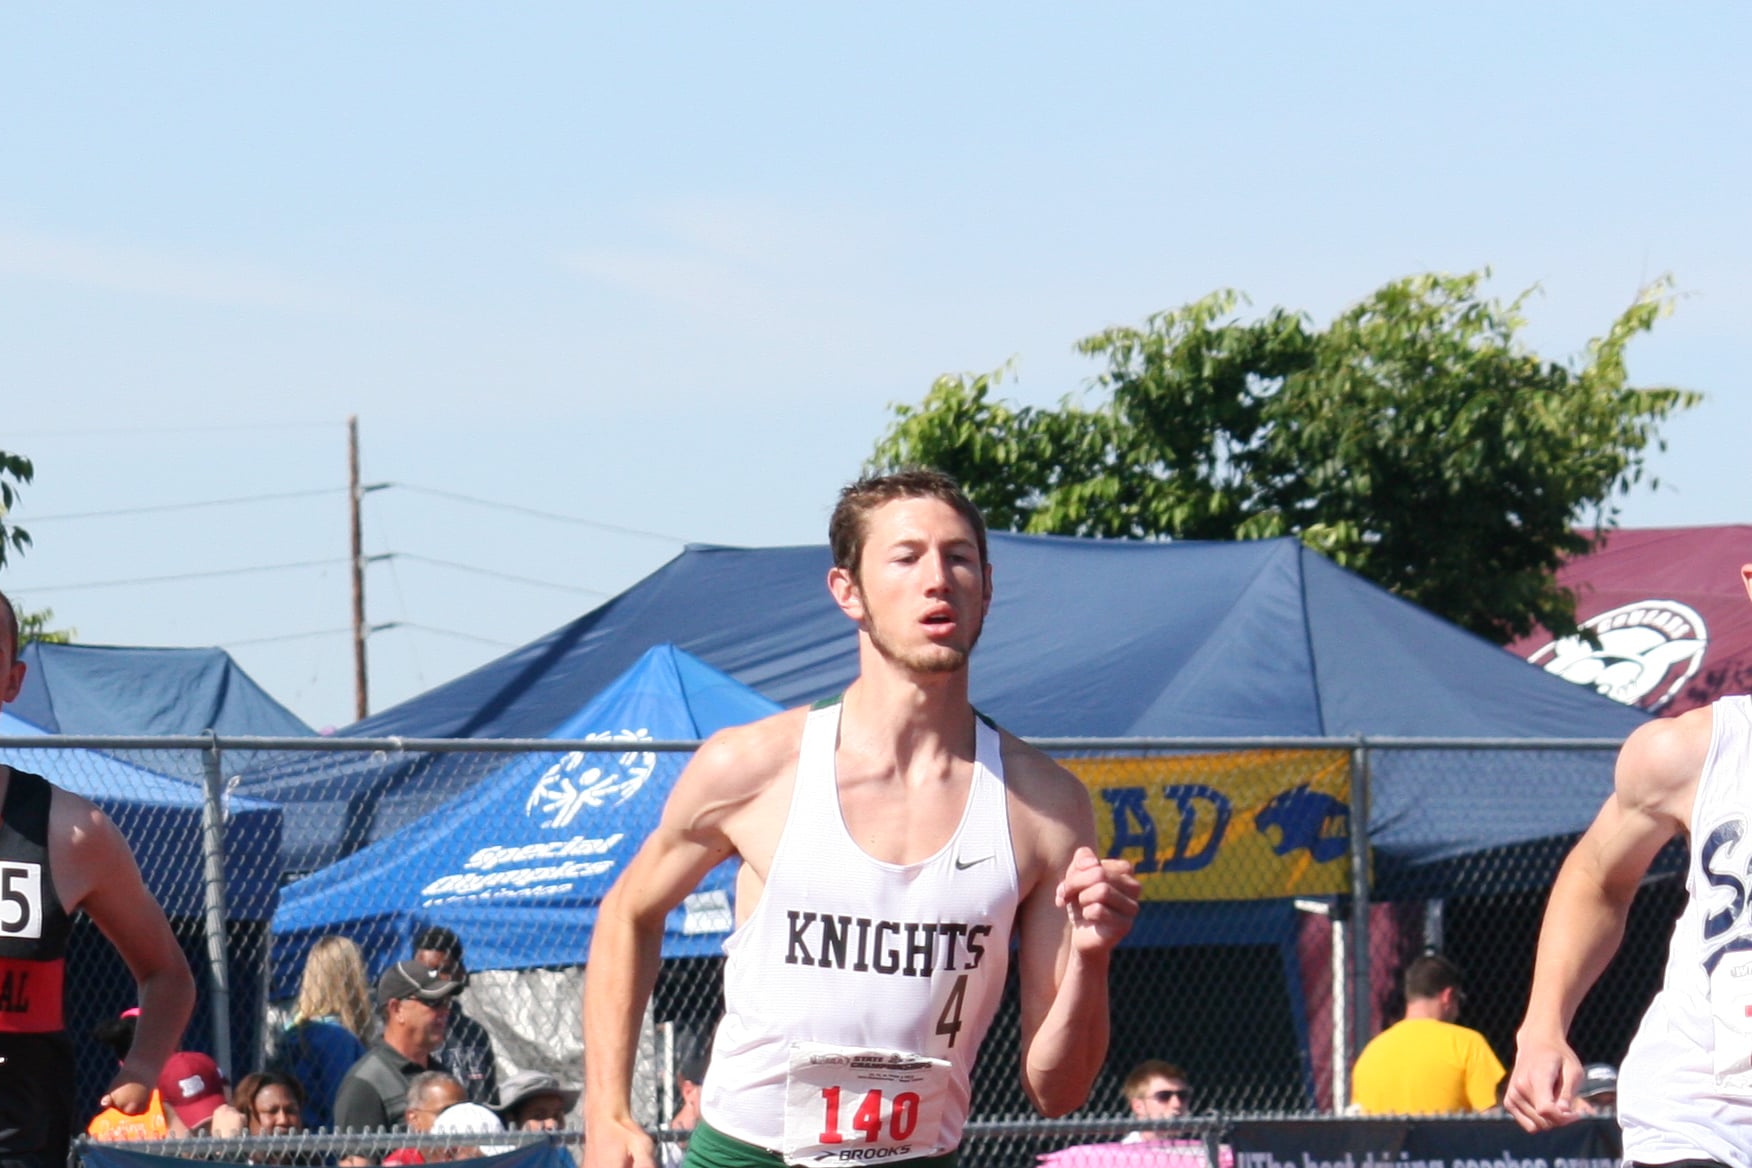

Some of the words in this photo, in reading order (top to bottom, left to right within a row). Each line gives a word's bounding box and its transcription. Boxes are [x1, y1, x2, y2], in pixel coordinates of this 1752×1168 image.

[422, 860, 615, 896] Olympics
[464, 833, 624, 870] Special
[1701, 818, 1752, 941] S
[0, 867, 30, 933] 5
[785, 910, 992, 977] KNIGHTS
[935, 974, 968, 1049] 4
[819, 1086, 921, 1145] 140
[839, 1144, 913, 1162] BROOKS
